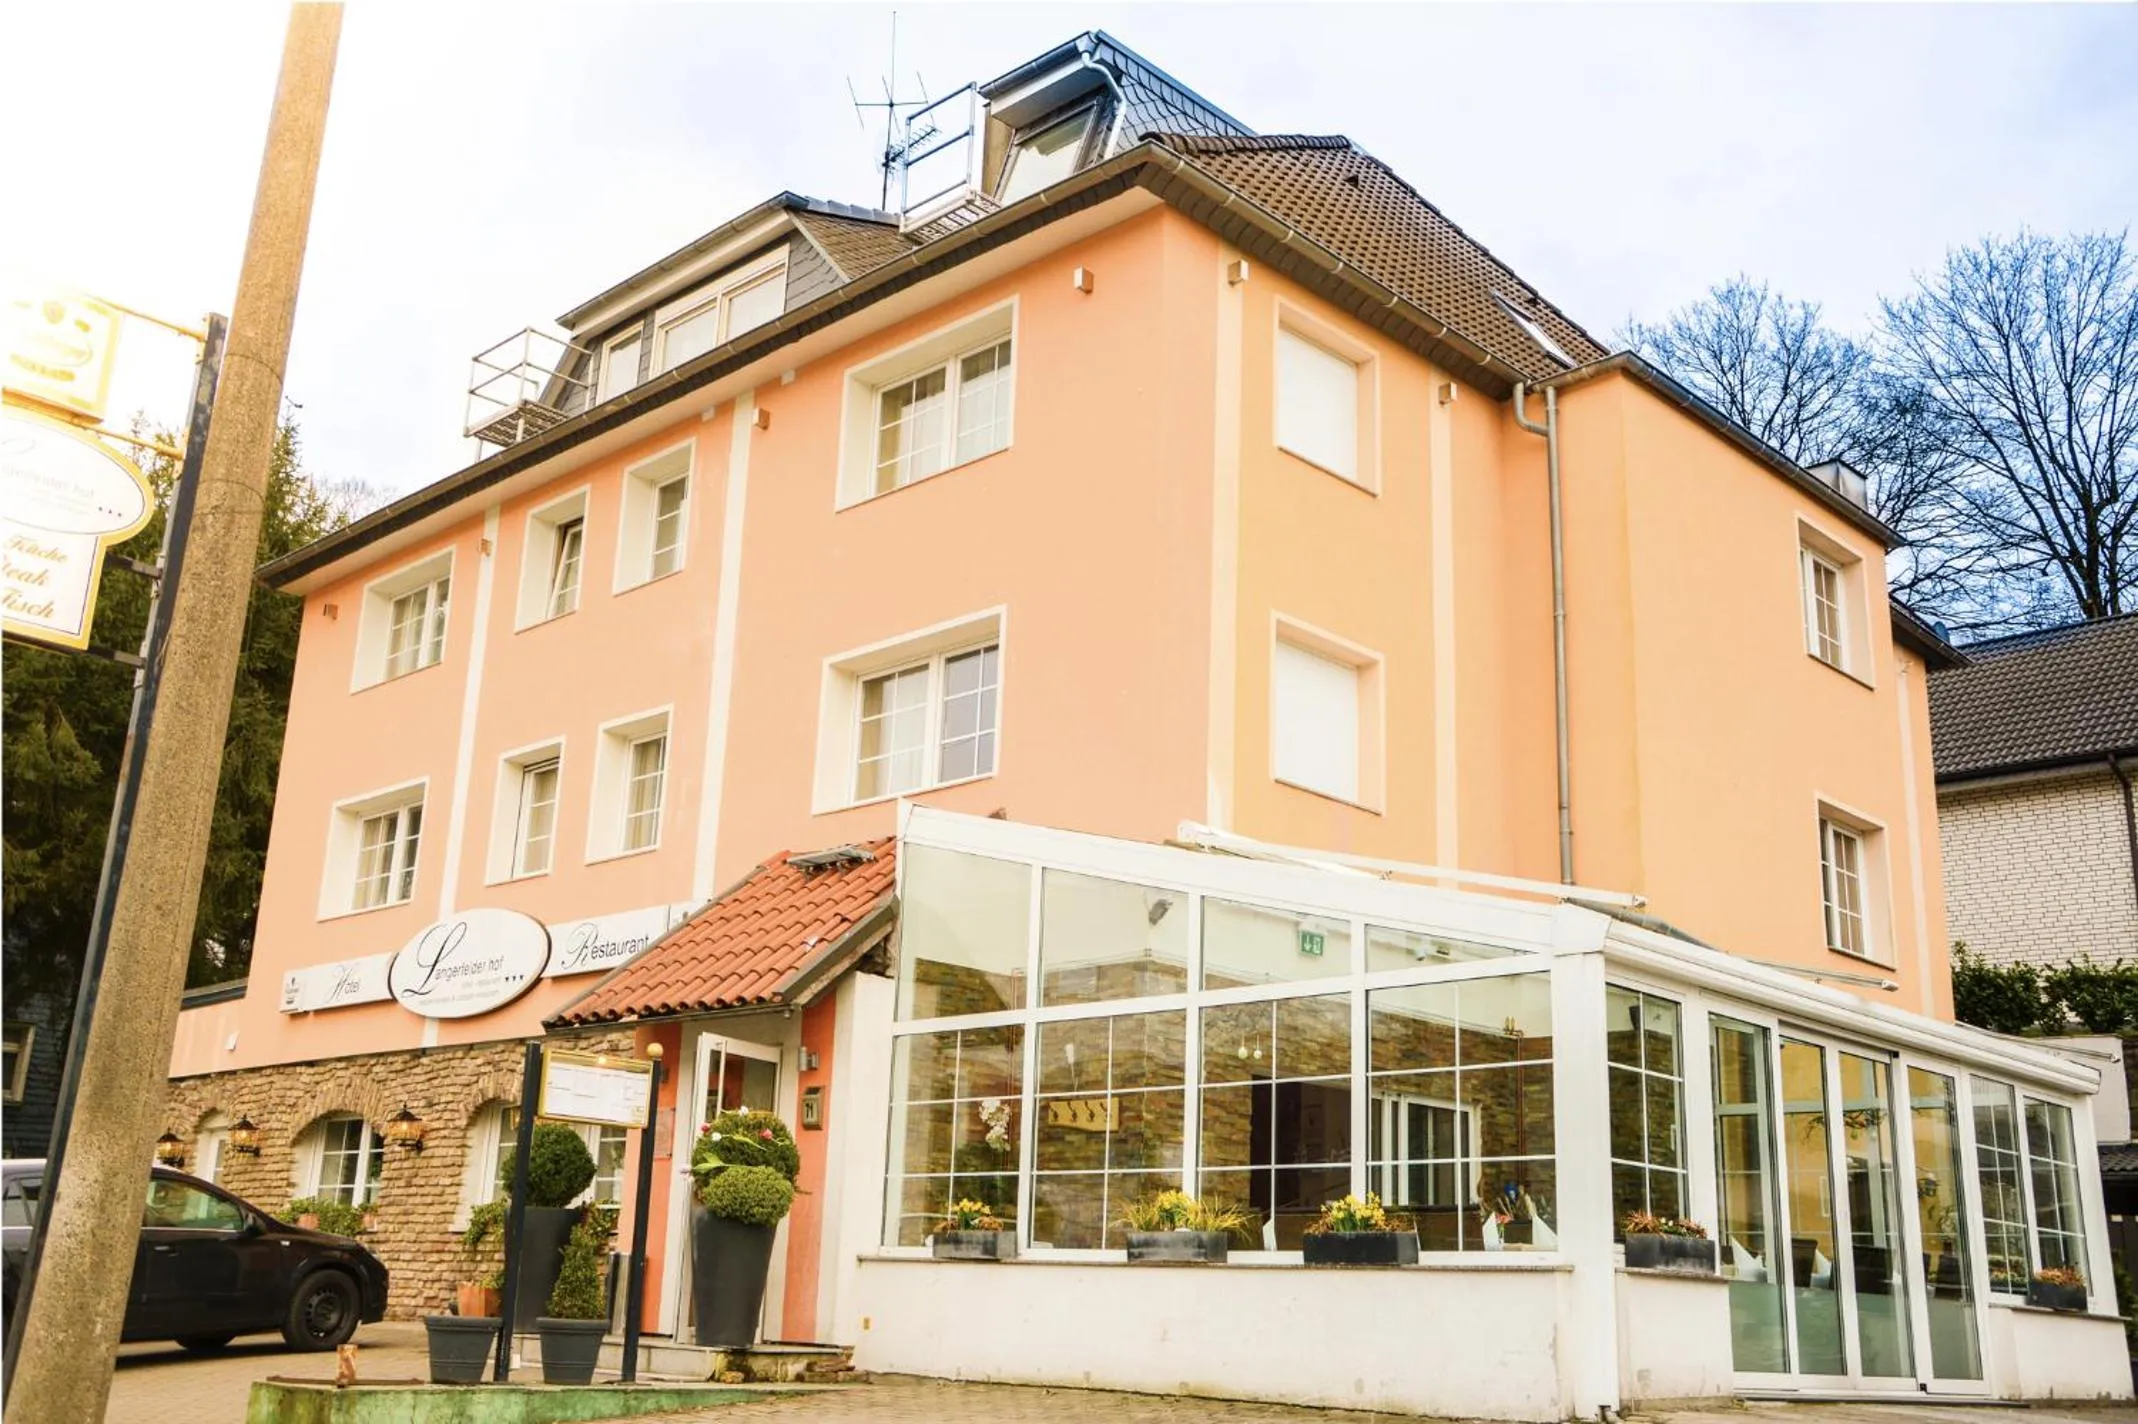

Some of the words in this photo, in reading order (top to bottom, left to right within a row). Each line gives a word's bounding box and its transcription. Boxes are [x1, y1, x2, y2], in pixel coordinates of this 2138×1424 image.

[401, 921, 486, 998] Langerfelder
[487, 955, 505, 973] hof
[561, 921, 650, 970] Restaurant
